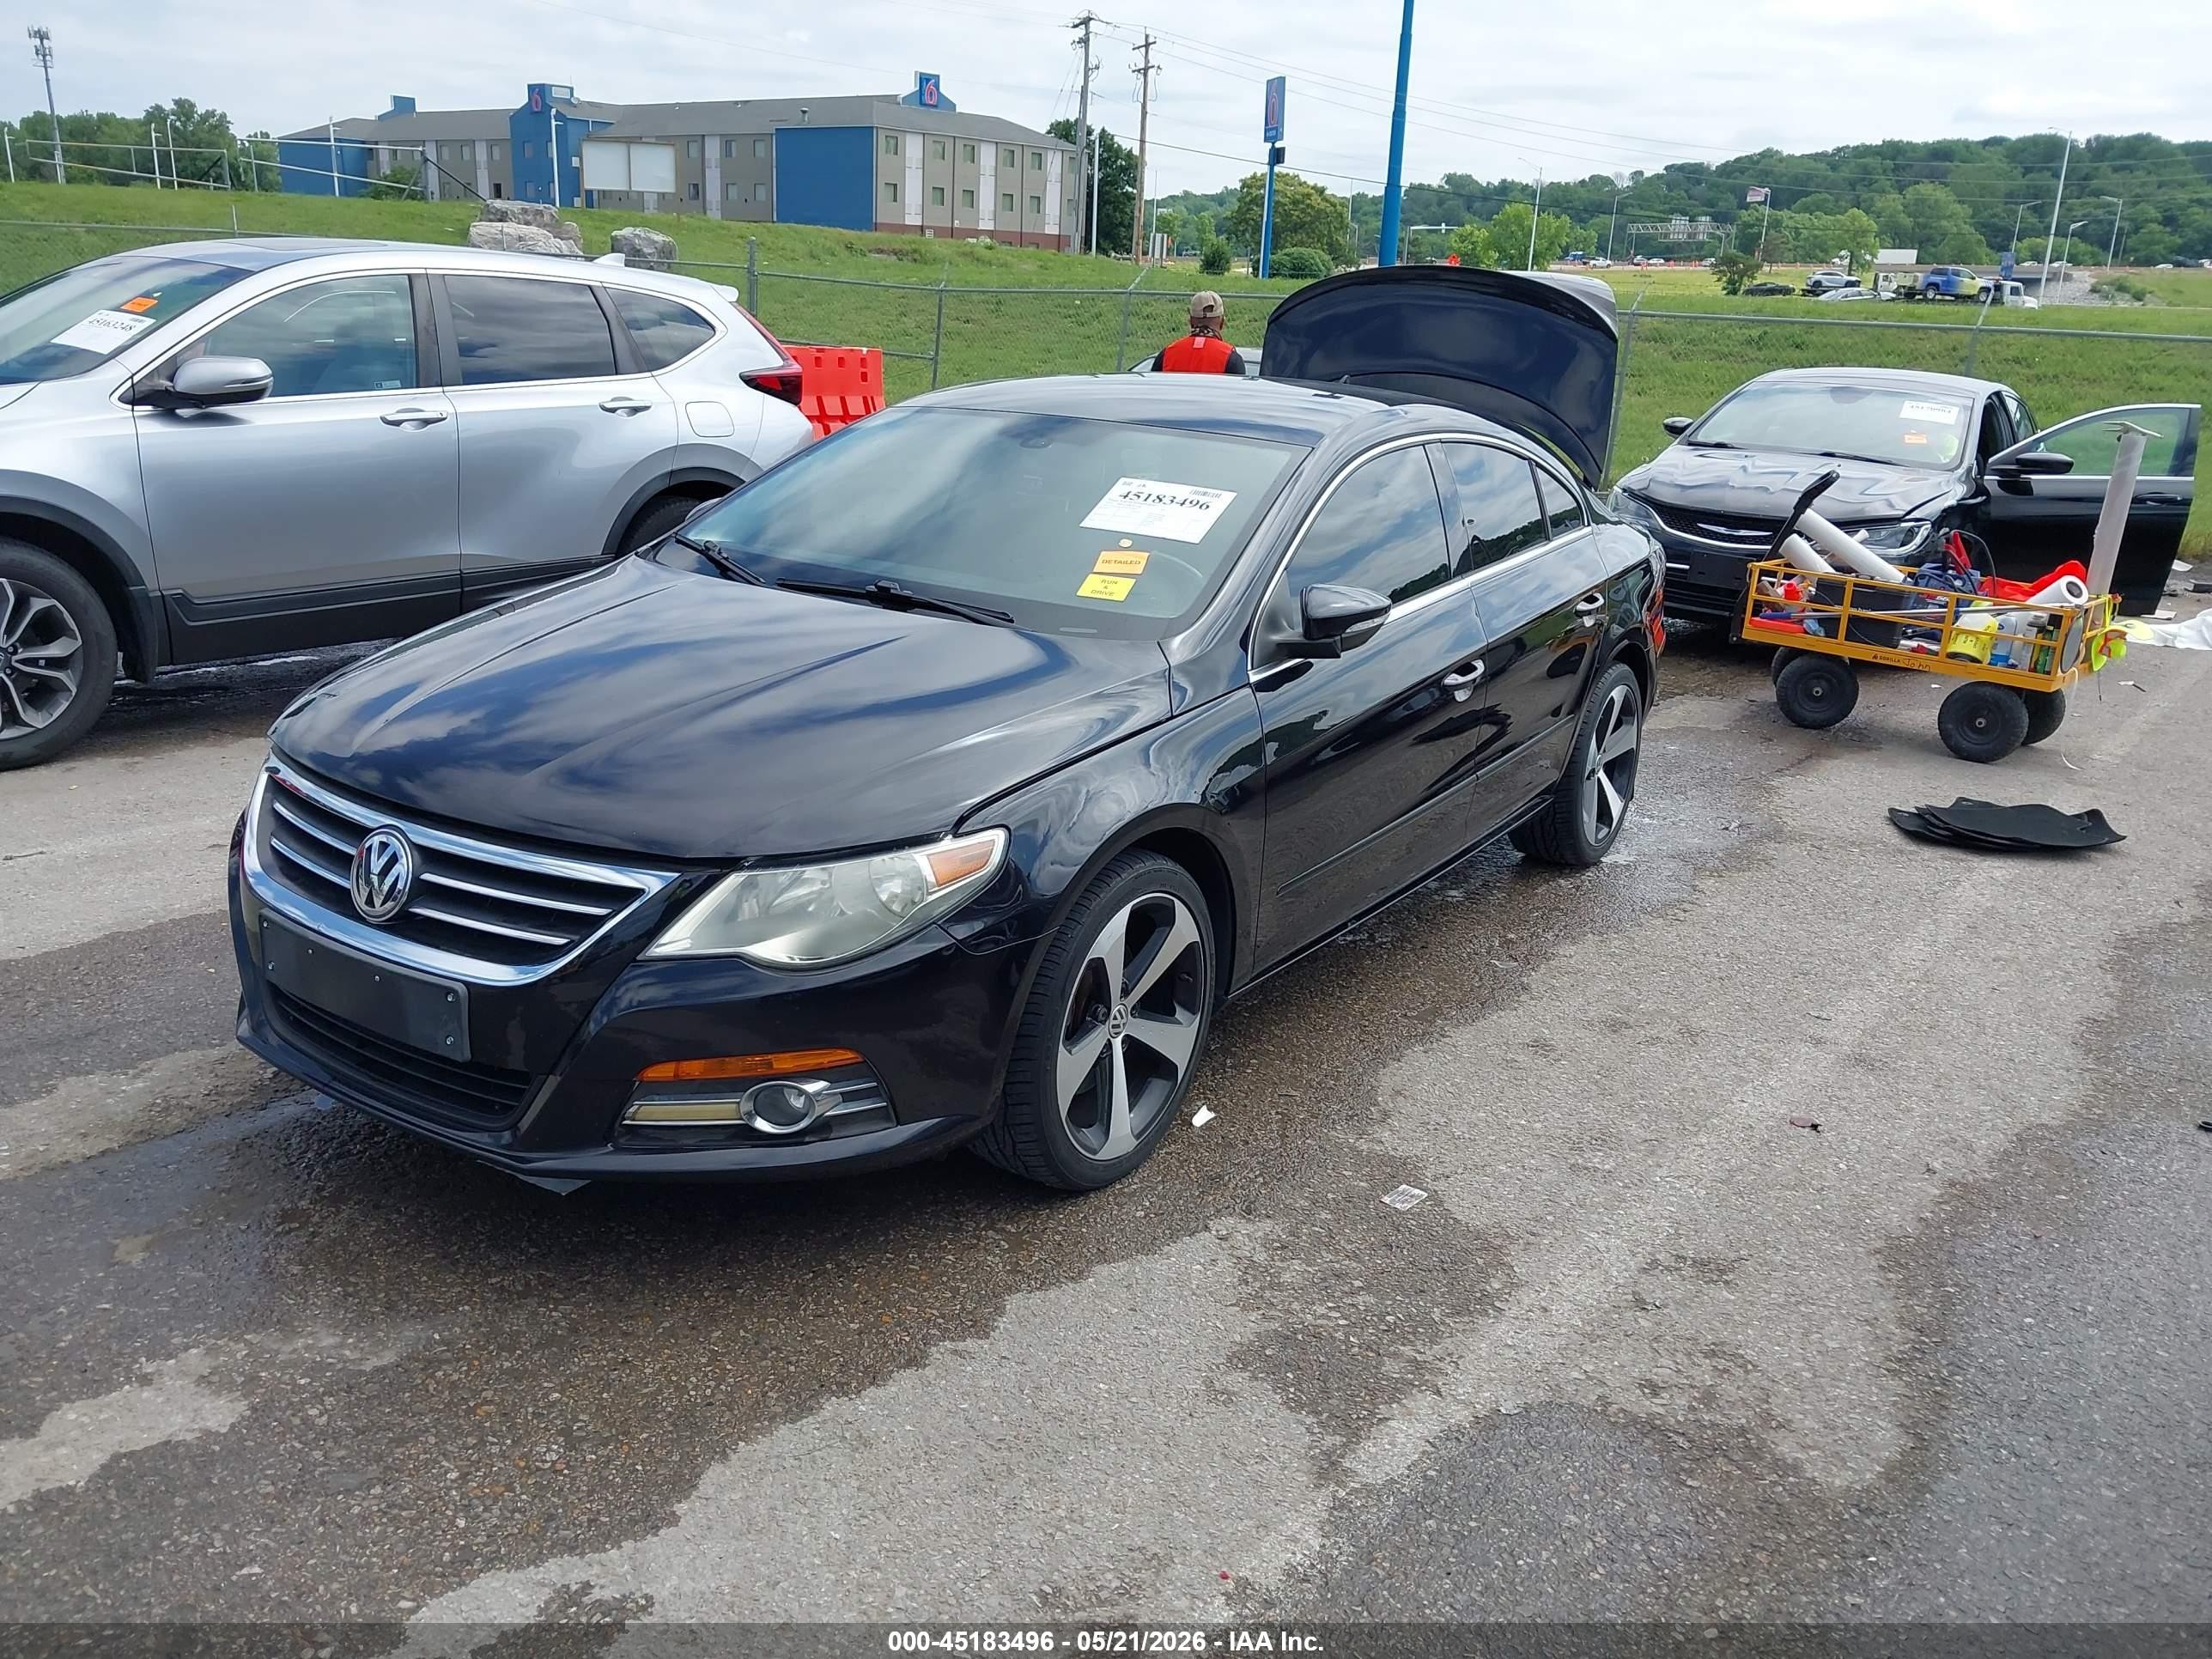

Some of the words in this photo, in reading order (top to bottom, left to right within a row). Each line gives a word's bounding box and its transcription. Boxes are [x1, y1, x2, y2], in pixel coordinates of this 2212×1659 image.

[531, 88, 542, 112] 6
[925, 79, 938, 105] 6
[1267, 81, 1279, 126] 6
[1119, 490, 1212, 510] 45183496
[1902, 657, 1931, 672] John
